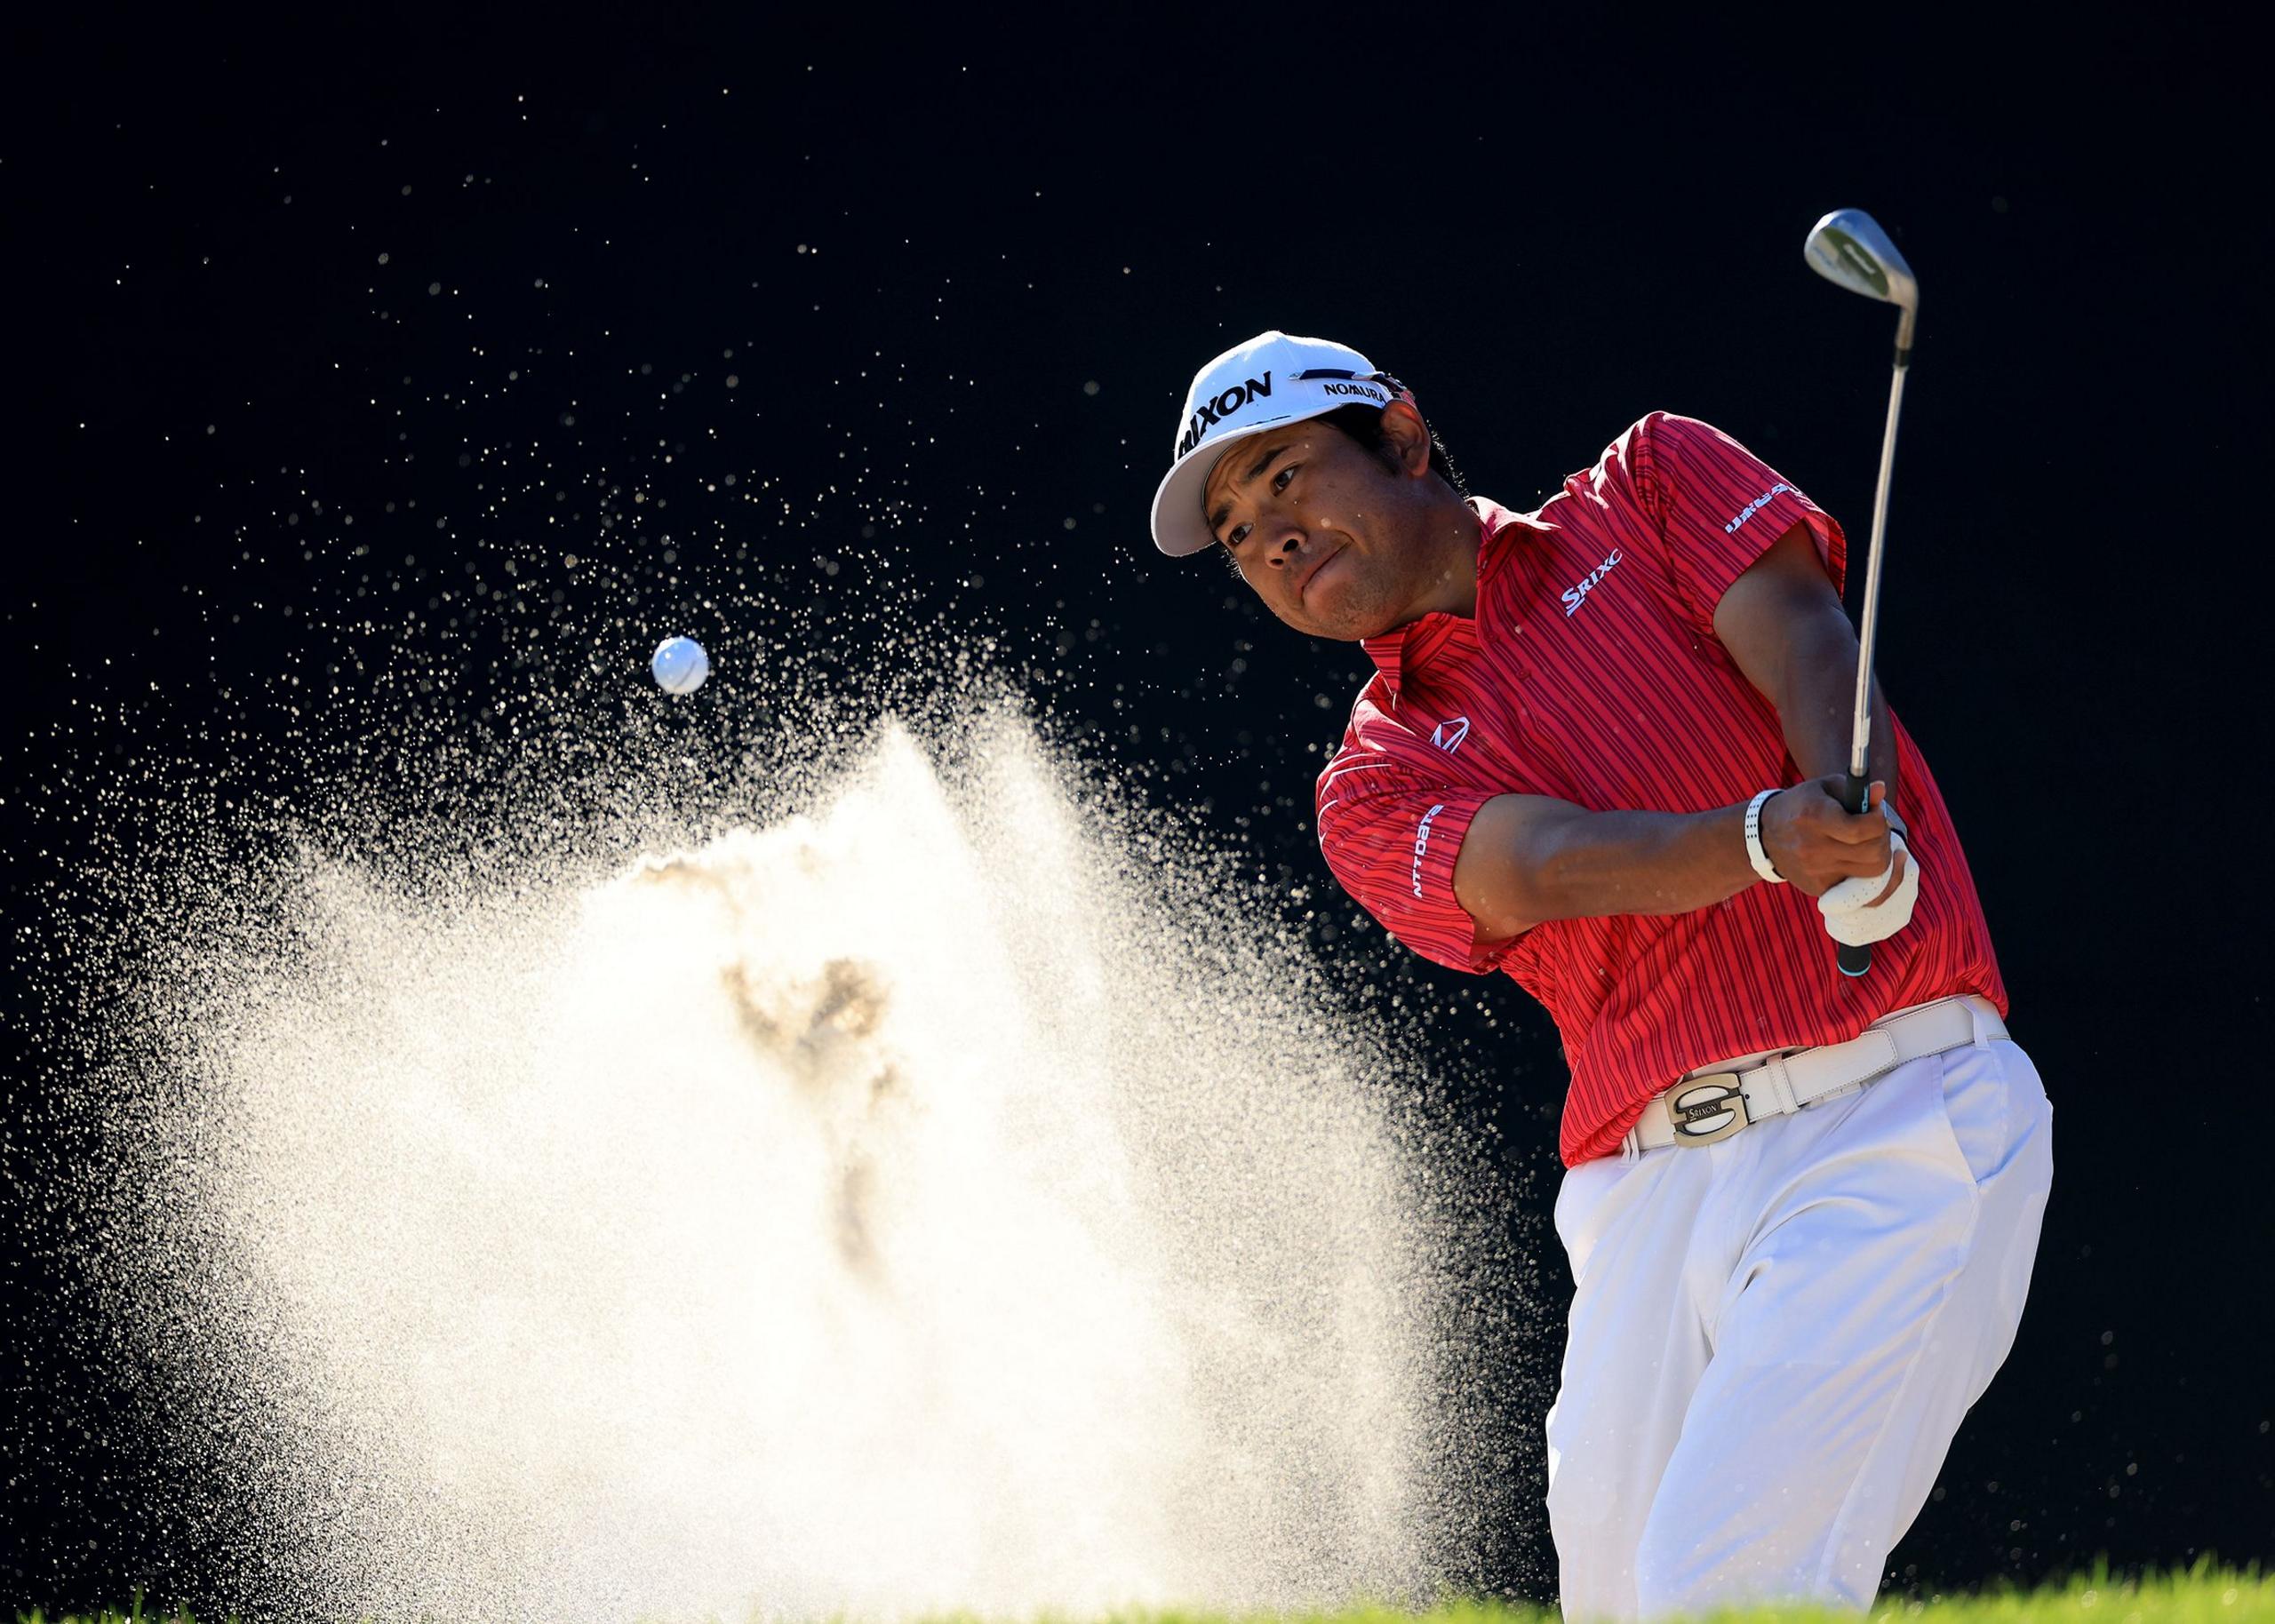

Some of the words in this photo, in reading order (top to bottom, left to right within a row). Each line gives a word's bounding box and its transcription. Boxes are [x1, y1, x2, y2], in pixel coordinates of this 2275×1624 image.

[1323, 383, 1386, 404] NOMURA
[1412, 856, 1423, 899] NTT
[1688, 1105, 1717, 1122] SRIXON
